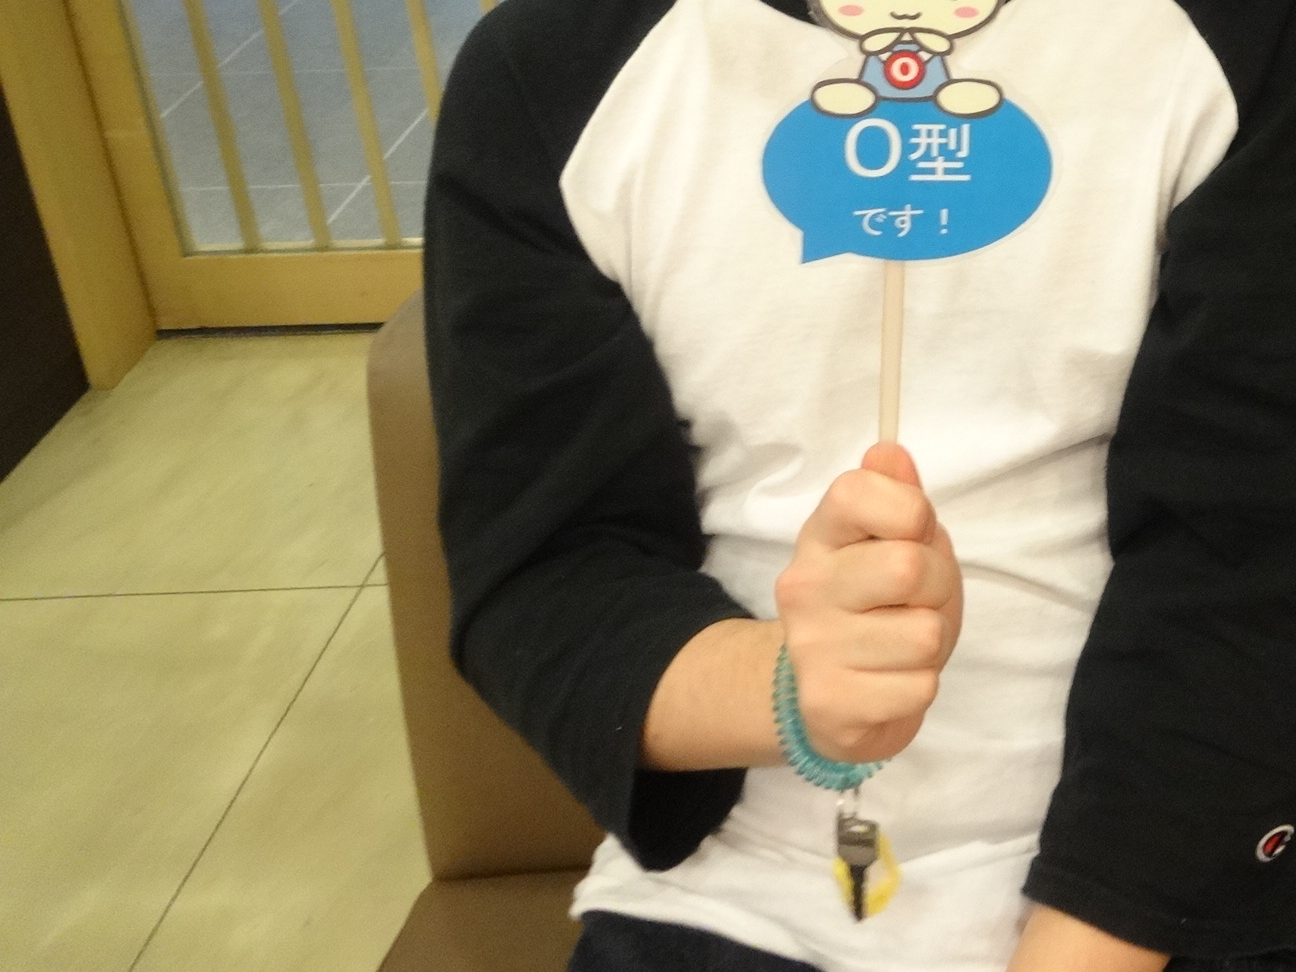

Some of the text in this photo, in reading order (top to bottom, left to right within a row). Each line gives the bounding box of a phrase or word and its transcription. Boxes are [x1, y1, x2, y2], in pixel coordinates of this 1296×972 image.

[888, 56, 920, 82] O
[843, 117, 972, 182] O型
[852, 203, 950, 238] です！
